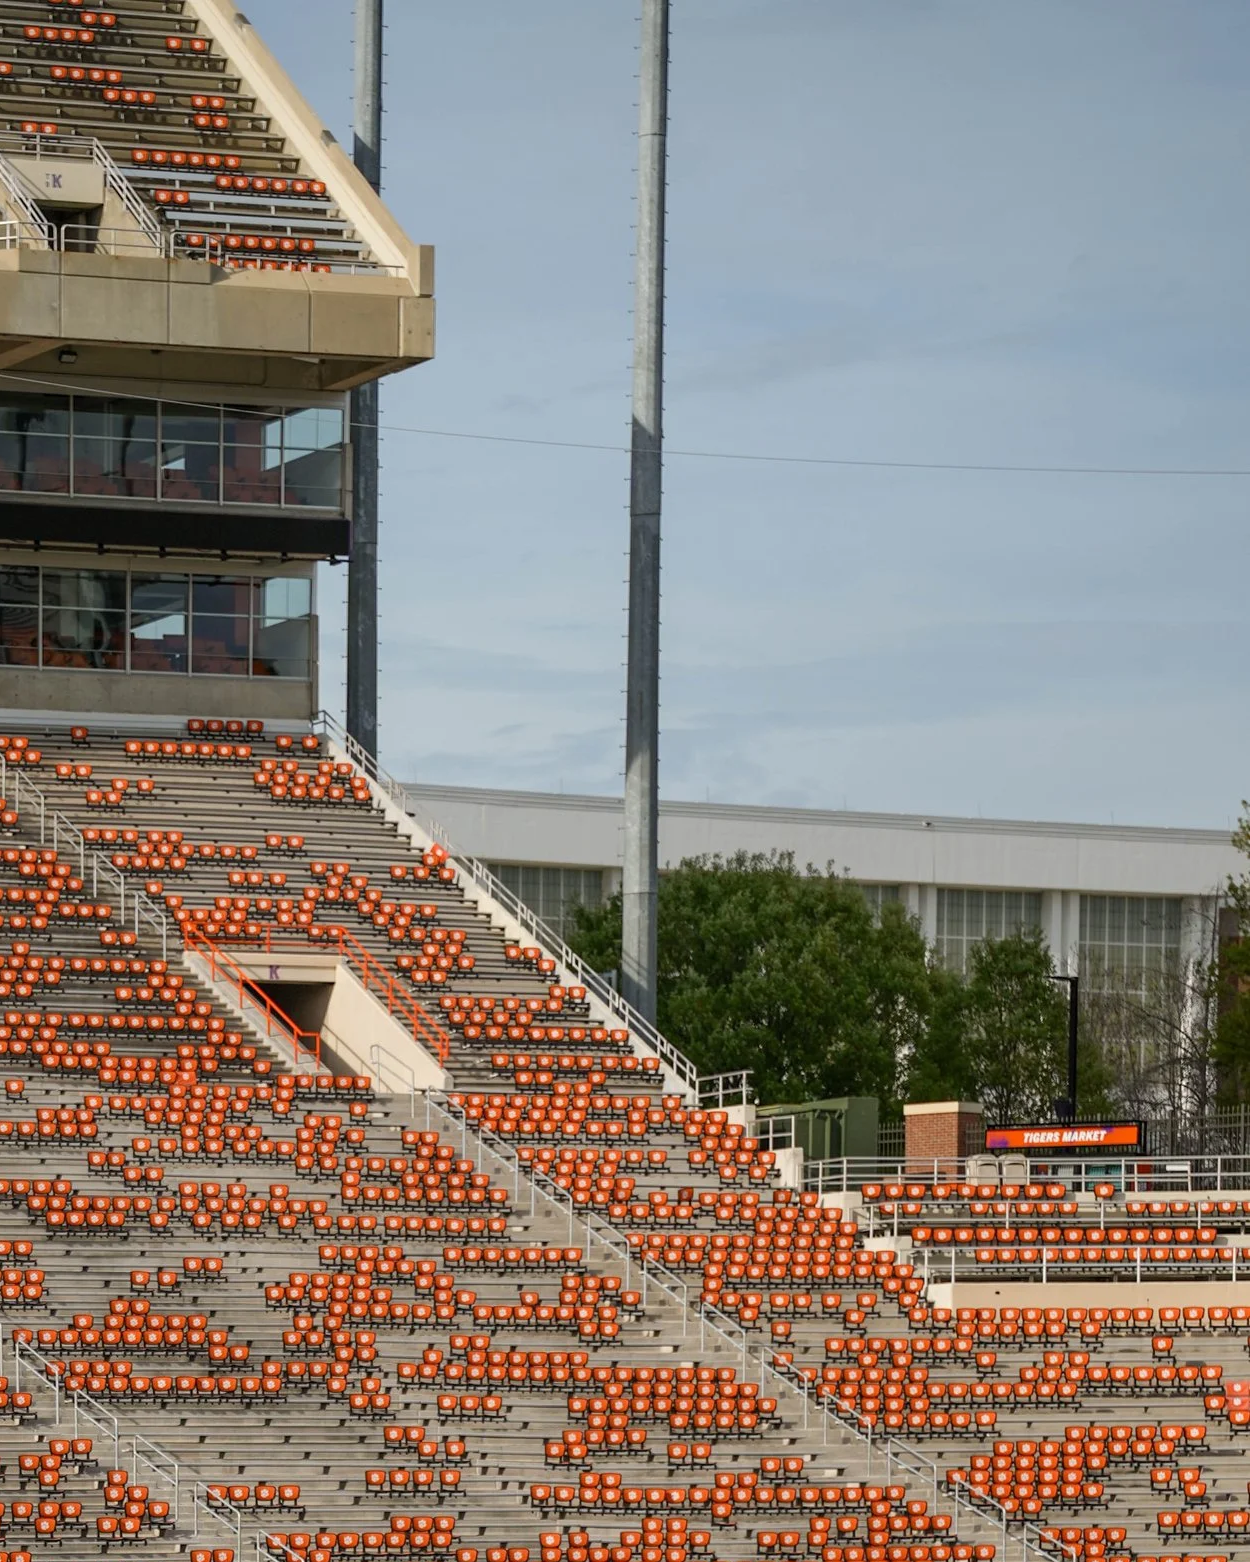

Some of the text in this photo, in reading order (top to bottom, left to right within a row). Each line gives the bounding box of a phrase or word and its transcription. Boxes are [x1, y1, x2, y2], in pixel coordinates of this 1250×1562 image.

[51, 173, 63, 189] K
[269, 965, 280, 980] K
[1023, 1130, 1107, 1143] TIGERS MARKET
